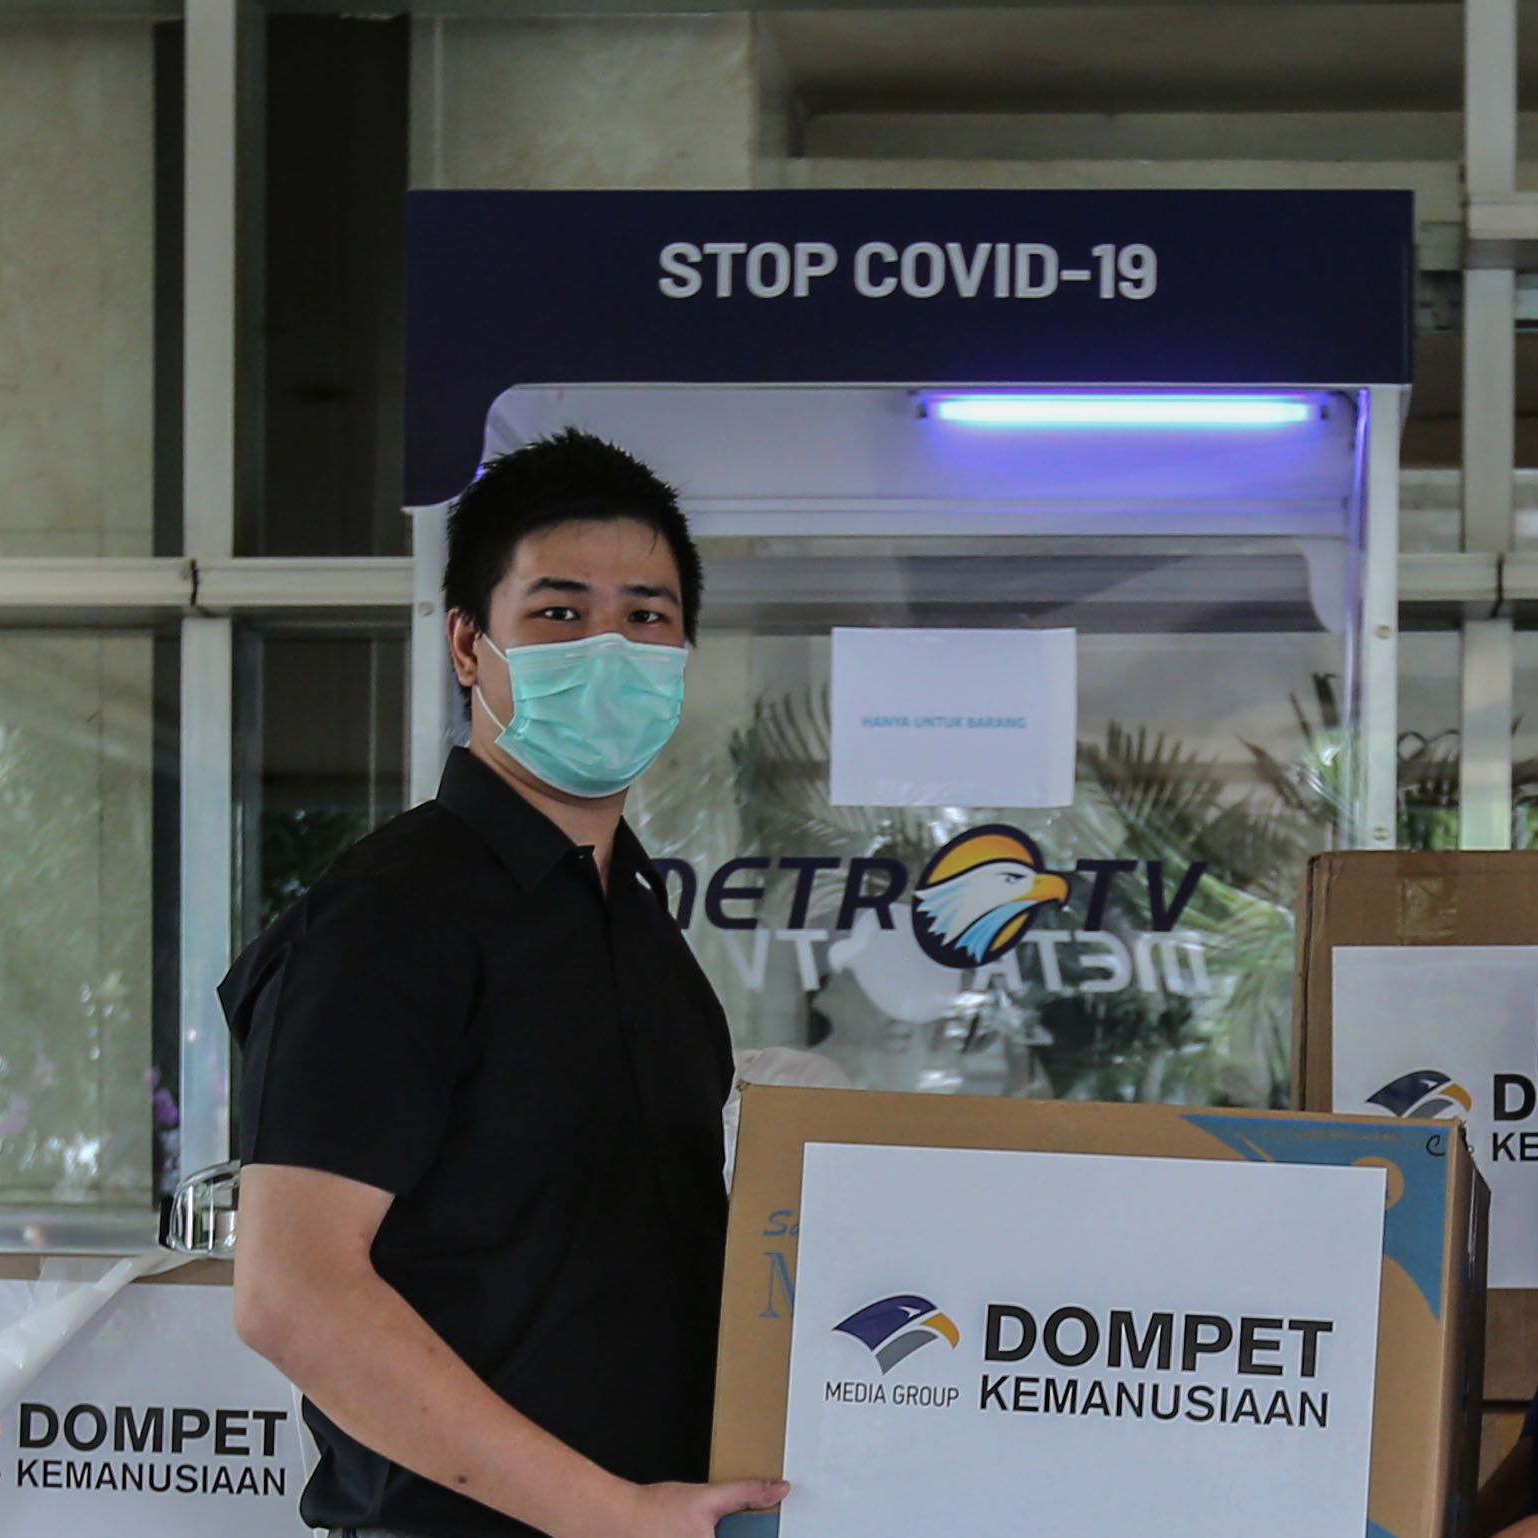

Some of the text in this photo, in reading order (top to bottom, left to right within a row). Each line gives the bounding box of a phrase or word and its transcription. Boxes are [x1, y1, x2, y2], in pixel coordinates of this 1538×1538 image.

[658, 242, 1158, 301] STOP COVID-19
[966, 715, 1027, 728] BARANG
[1074, 859, 1210, 932] TV
[985, 1304, 1333, 1378] DOMPET
[826, 1381, 959, 1407] MEDIA GROUP
[981, 1375, 1328, 1427] KEMANUSIAAN
[20, 1403, 287, 1456] DOMPET
[18, 1459, 285, 1496] KEMANUSIAAN
